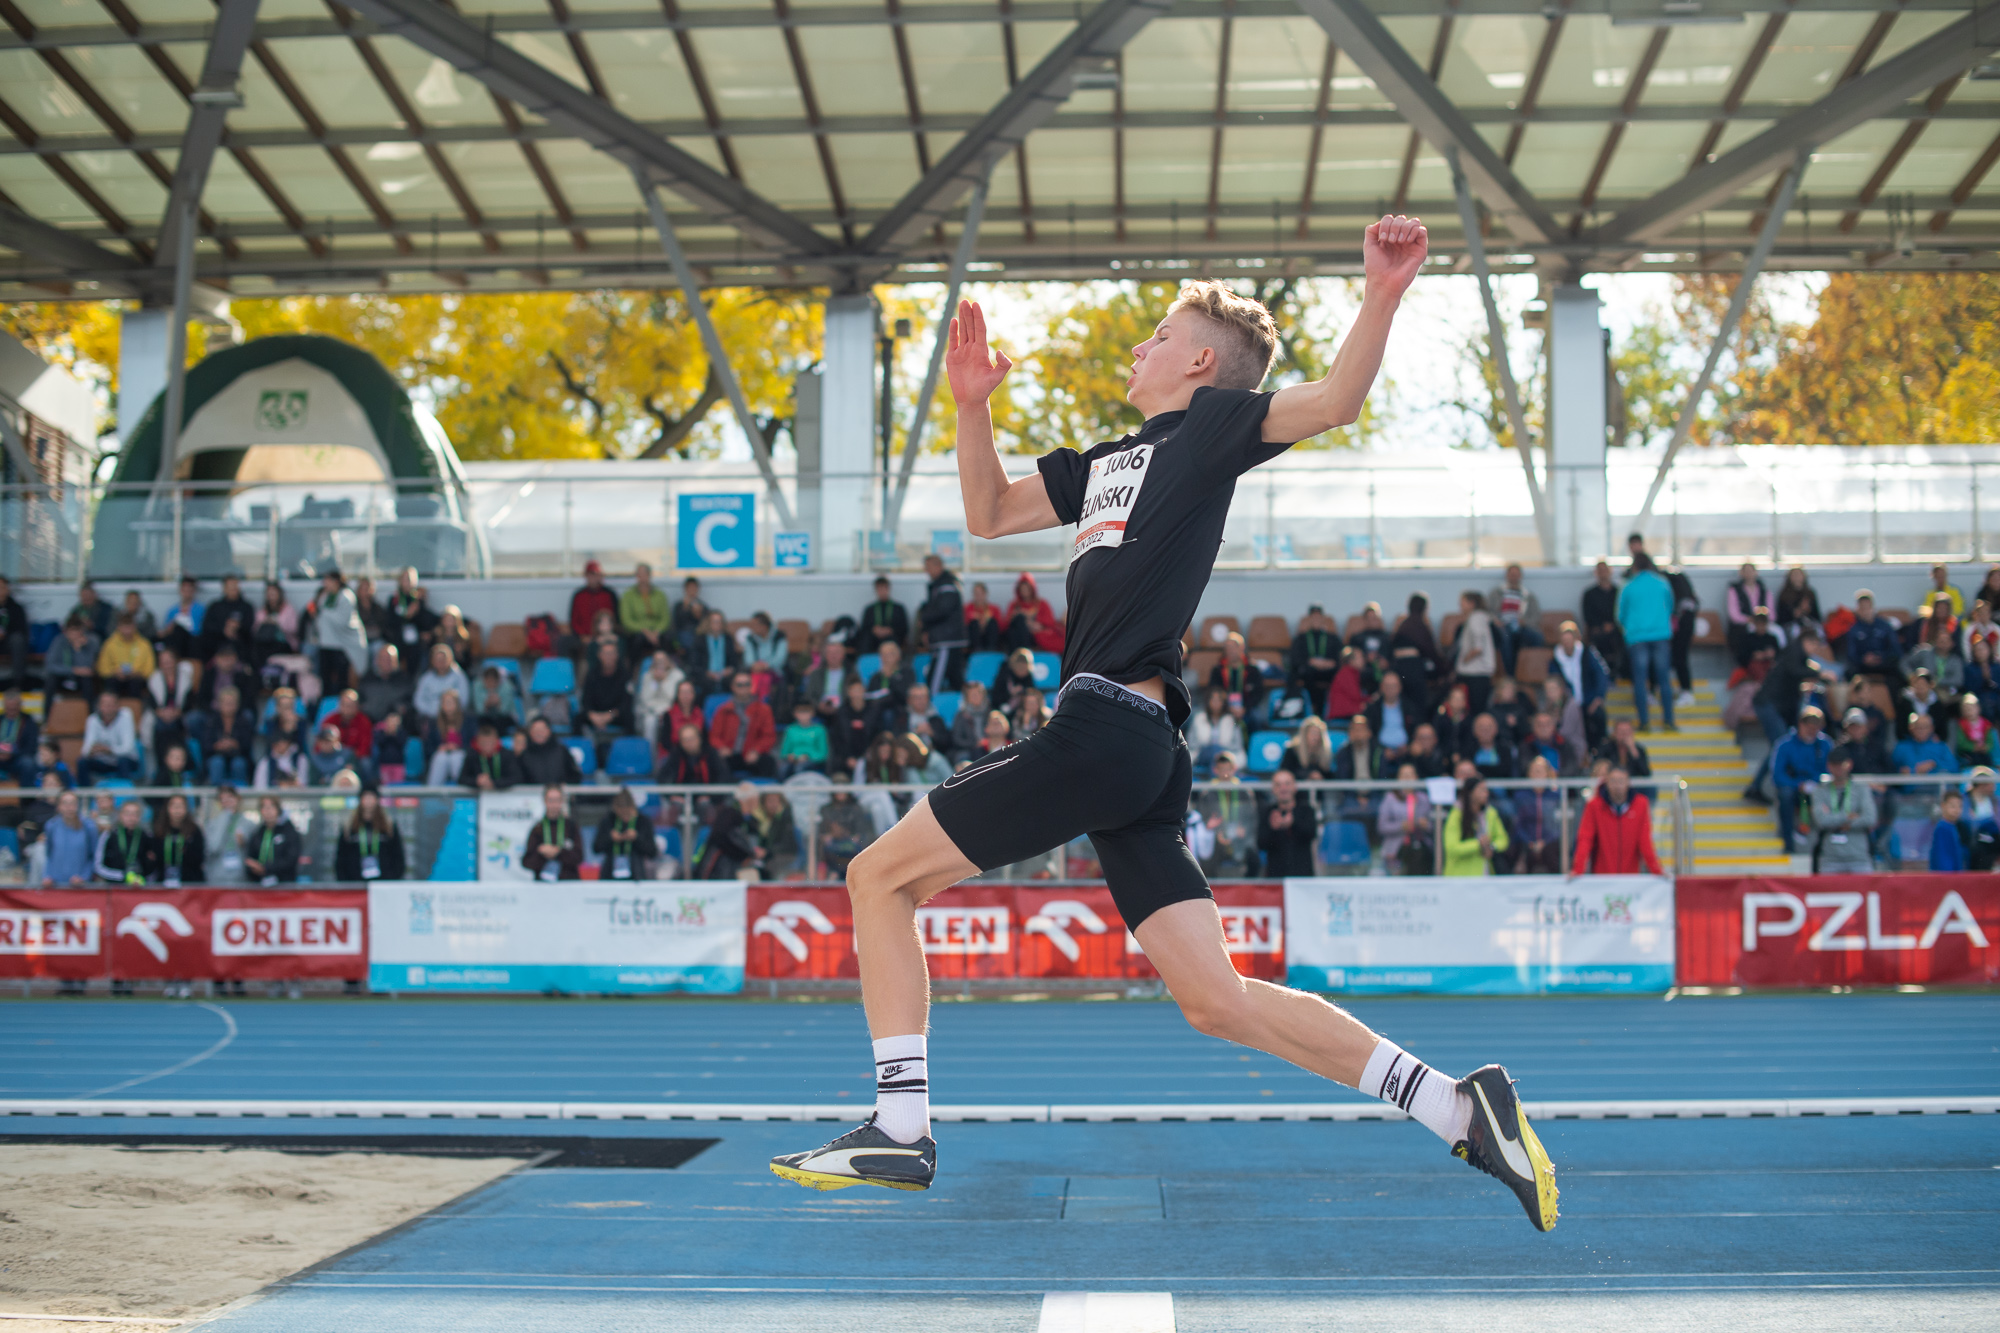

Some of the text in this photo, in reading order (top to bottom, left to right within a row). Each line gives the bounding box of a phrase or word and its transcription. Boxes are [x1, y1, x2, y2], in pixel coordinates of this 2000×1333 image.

[1103, 448, 1147, 477] 1006
[1080, 486, 1135, 522] ELIŃSKI
[694, 511, 739, 566] C
[775, 537, 808, 554] WC
[1069, 677, 1118, 699] NIKE
[1117, 690, 1158, 715] PRO
[0, 919, 87, 945] RLEN
[223, 918, 348, 945] ORLEN
[925, 917, 995, 944] LEN
[1743, 890, 1990, 951] PZLA
[884, 1064, 903, 1074] NIKE
[1386, 1072, 1398, 1096] NIKE
